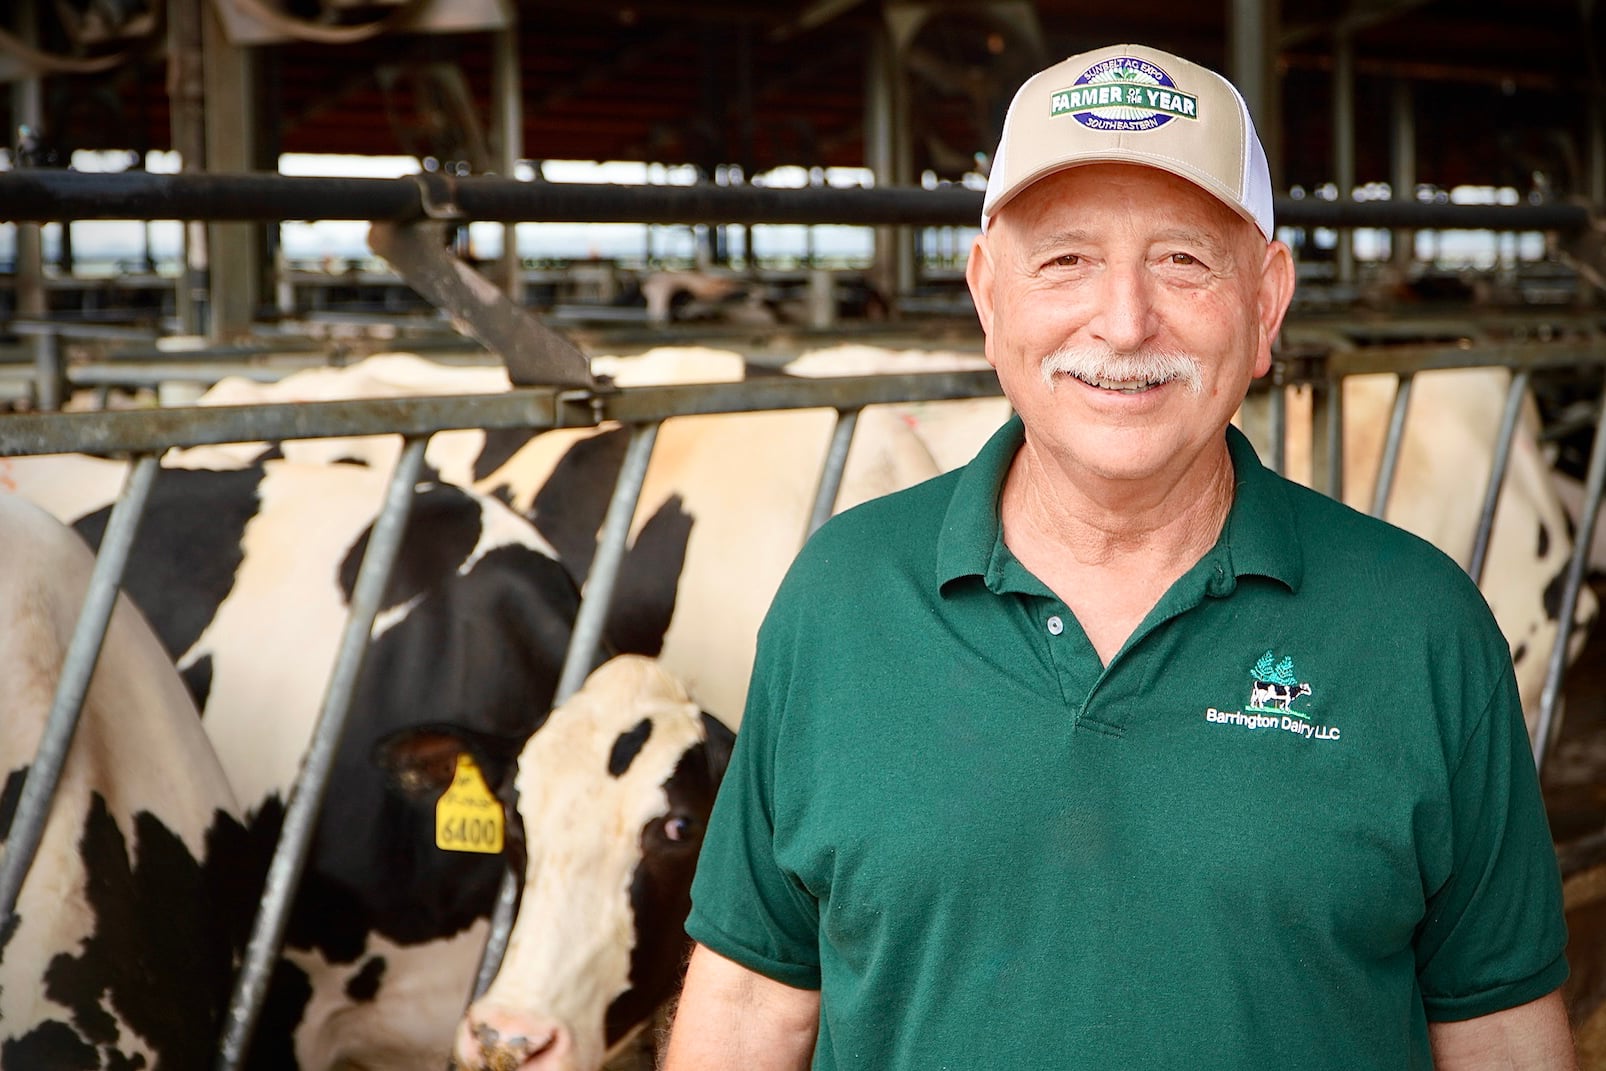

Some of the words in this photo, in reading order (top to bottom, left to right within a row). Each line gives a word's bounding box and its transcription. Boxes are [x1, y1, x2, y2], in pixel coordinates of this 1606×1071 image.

[1083, 58, 1125, 81] SUNBELT
[1124, 59, 1139, 70] AG
[1140, 62, 1163, 81] EXPO
[1051, 86, 1122, 113] FARMER
[1126, 95, 1142, 104] THE
[1128, 87, 1142, 96] OF
[1147, 89, 1195, 116] YEAR
[1085, 117, 1159, 130] SOUTHEASTERN
[1206, 708, 1279, 729] Barrington
[1281, 717, 1315, 738] Dairy
[1315, 726, 1340, 740] LLC
[442, 817, 496, 846] 6400
